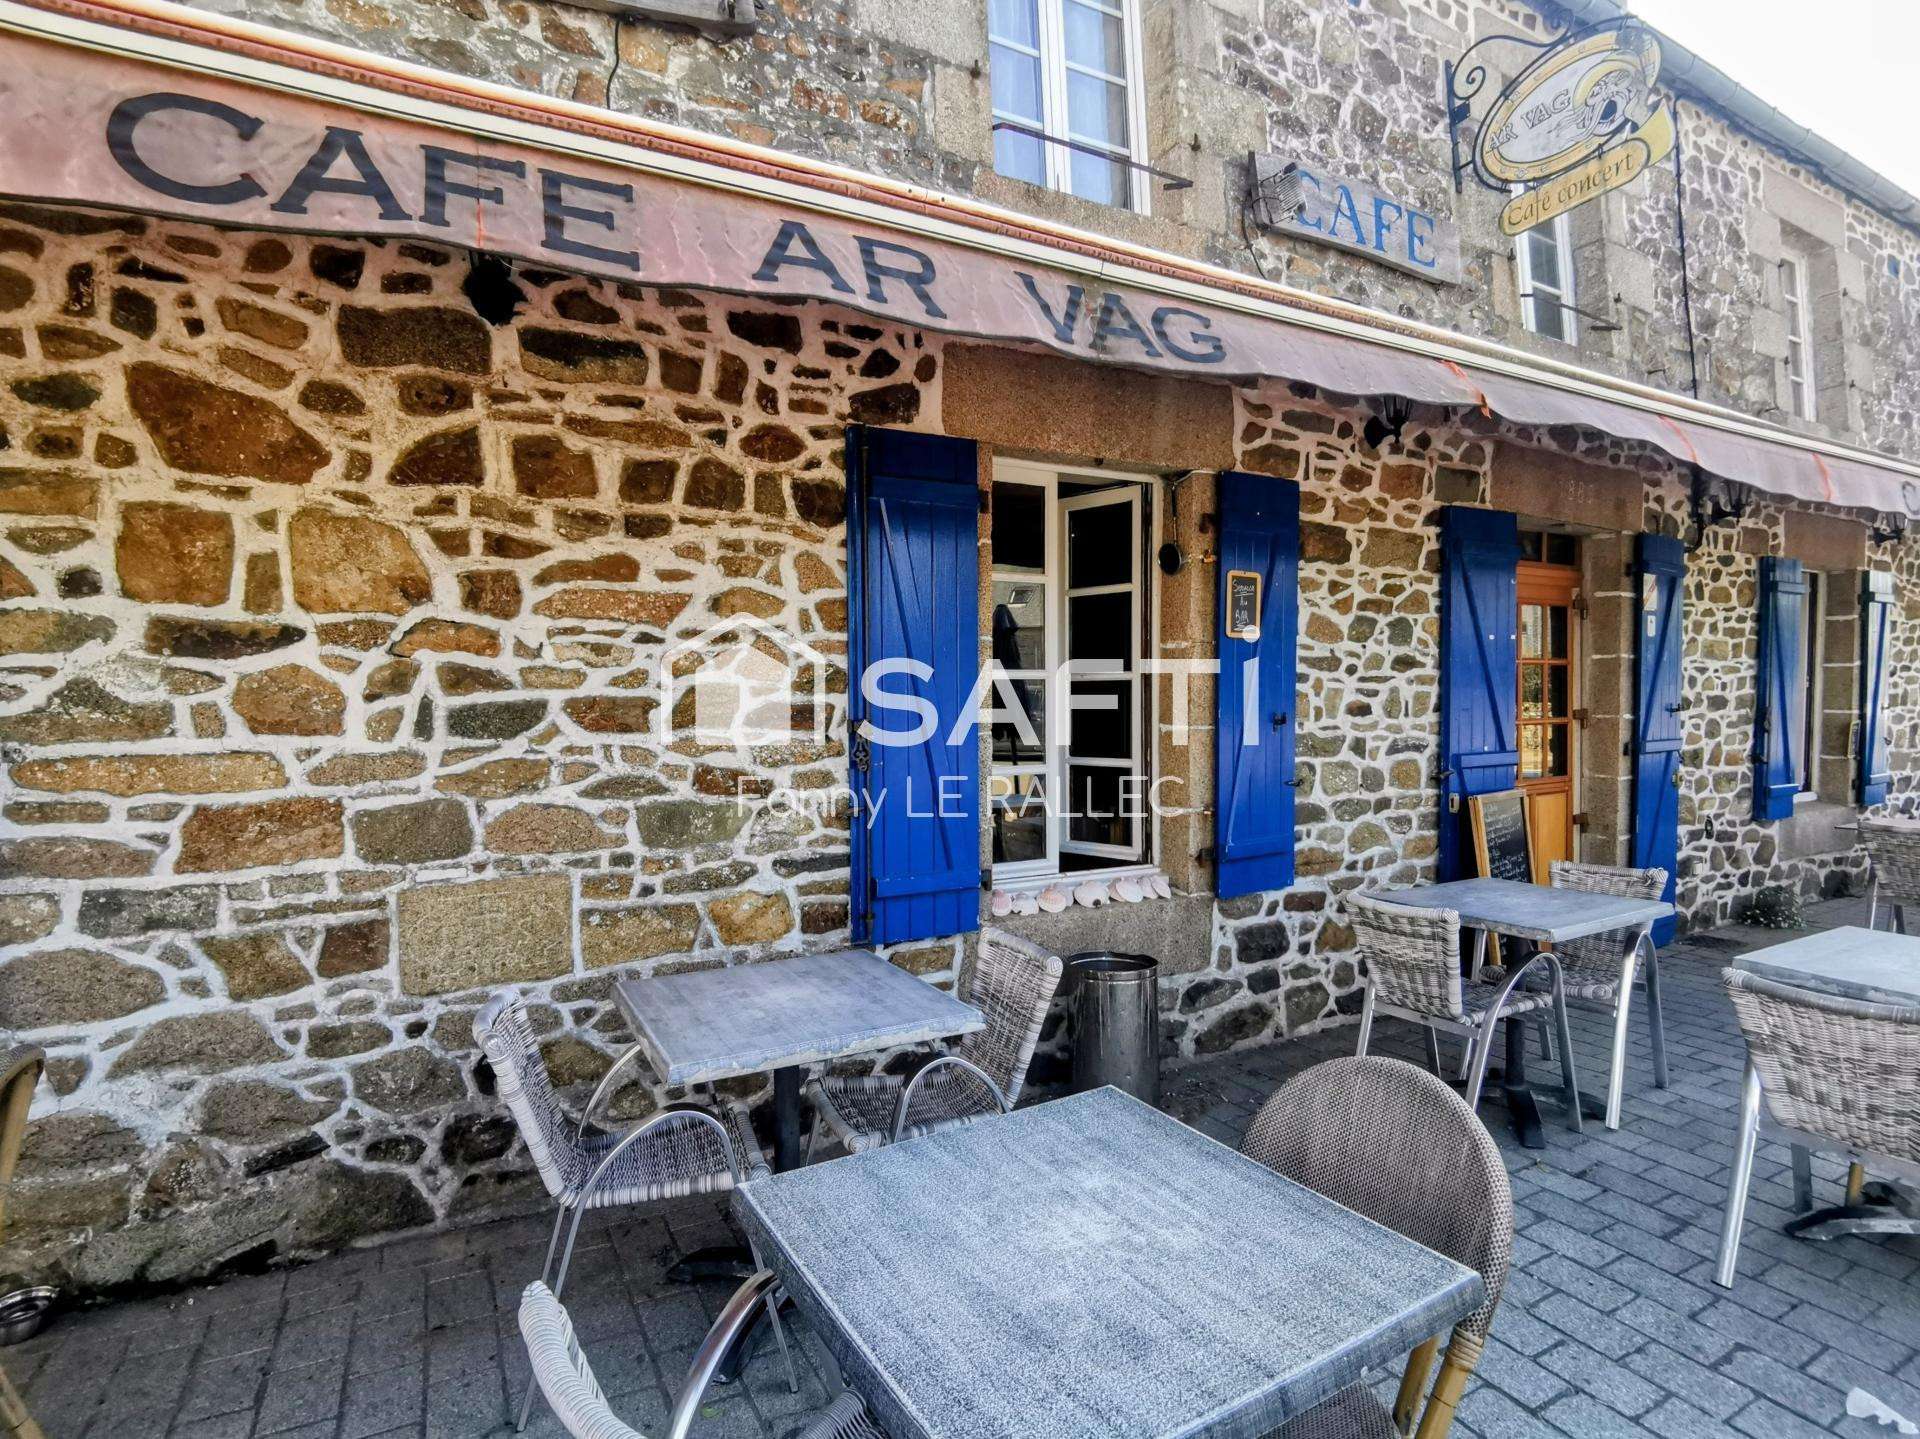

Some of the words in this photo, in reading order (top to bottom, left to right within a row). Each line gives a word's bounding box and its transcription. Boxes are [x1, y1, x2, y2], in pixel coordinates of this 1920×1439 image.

[1485, 122, 1519, 154] AR
[1521, 88, 1571, 130] VAG
[1296, 169, 1436, 268] CAFE
[1557, 152, 1635, 204] concert
[106, 91, 640, 272] CAFE
[751, 218, 948, 319] AR
[1014, 270, 1227, 364] VAG
